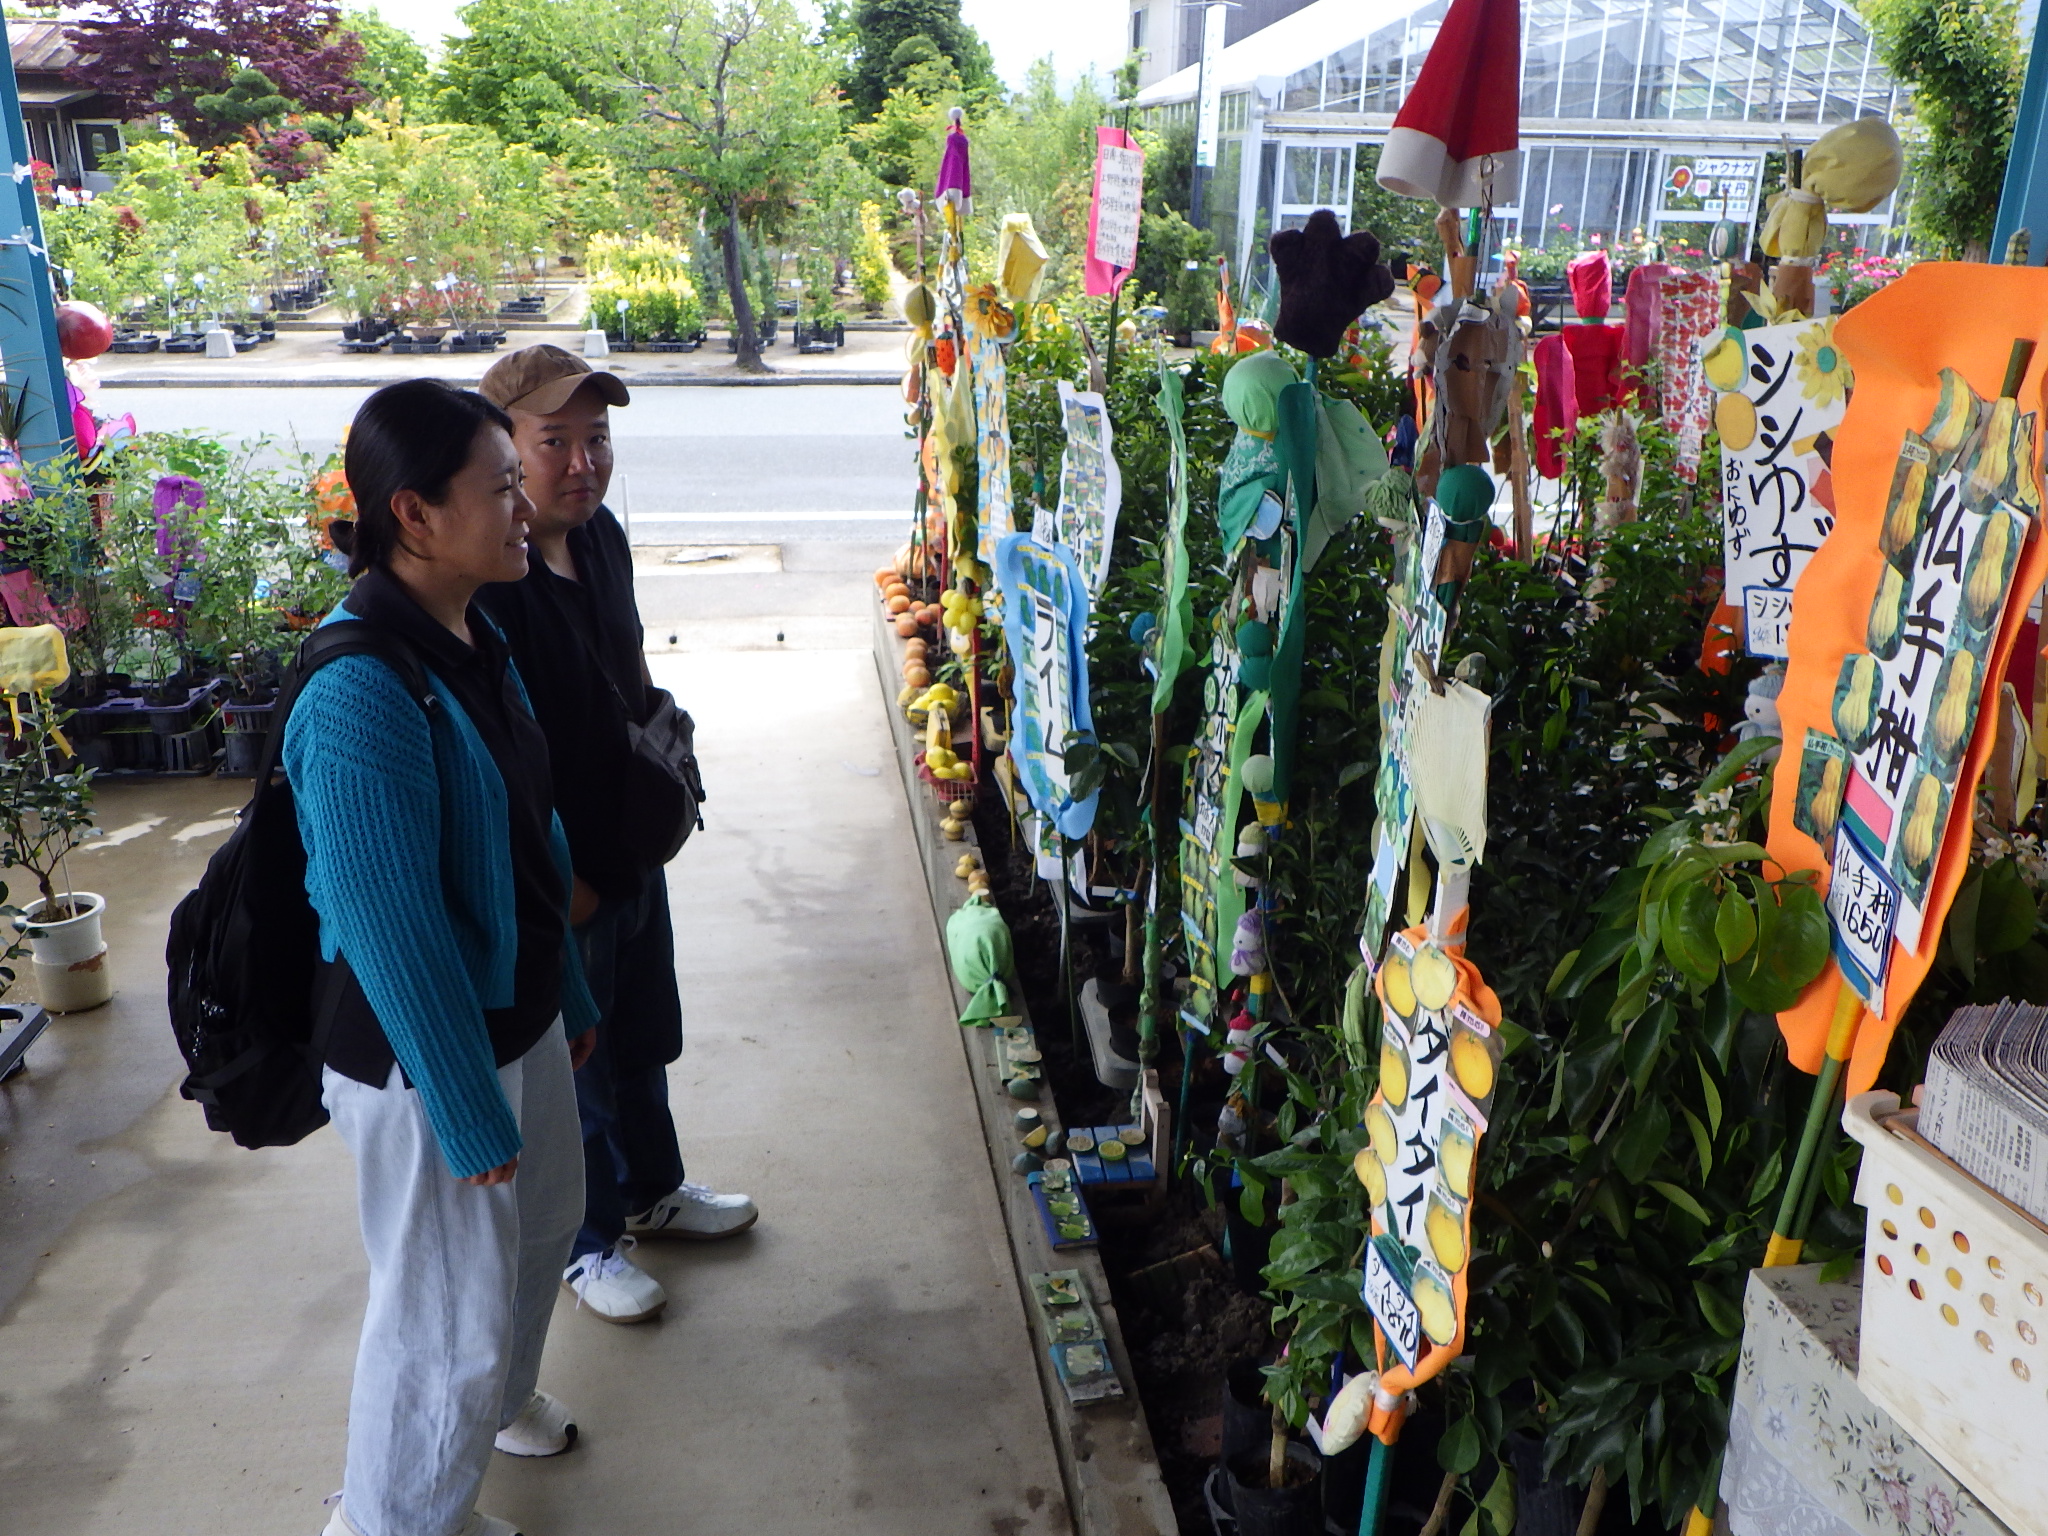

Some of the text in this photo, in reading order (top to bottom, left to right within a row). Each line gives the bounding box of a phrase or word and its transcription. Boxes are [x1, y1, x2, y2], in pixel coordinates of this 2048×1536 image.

[1697, 161, 1754, 175] シャクナゲ
[1725, 458, 1752, 561] おにゆず
[1749, 343, 1834, 589] シシゆず
[1036, 596, 1066, 760] ライム
[1866, 484, 1966, 799] 仏手柑
[1837, 840, 1893, 924] 仏手柑
[1842, 894, 1885, 953] 1650
[1397, 1016, 1452, 1236] ダイダイ
